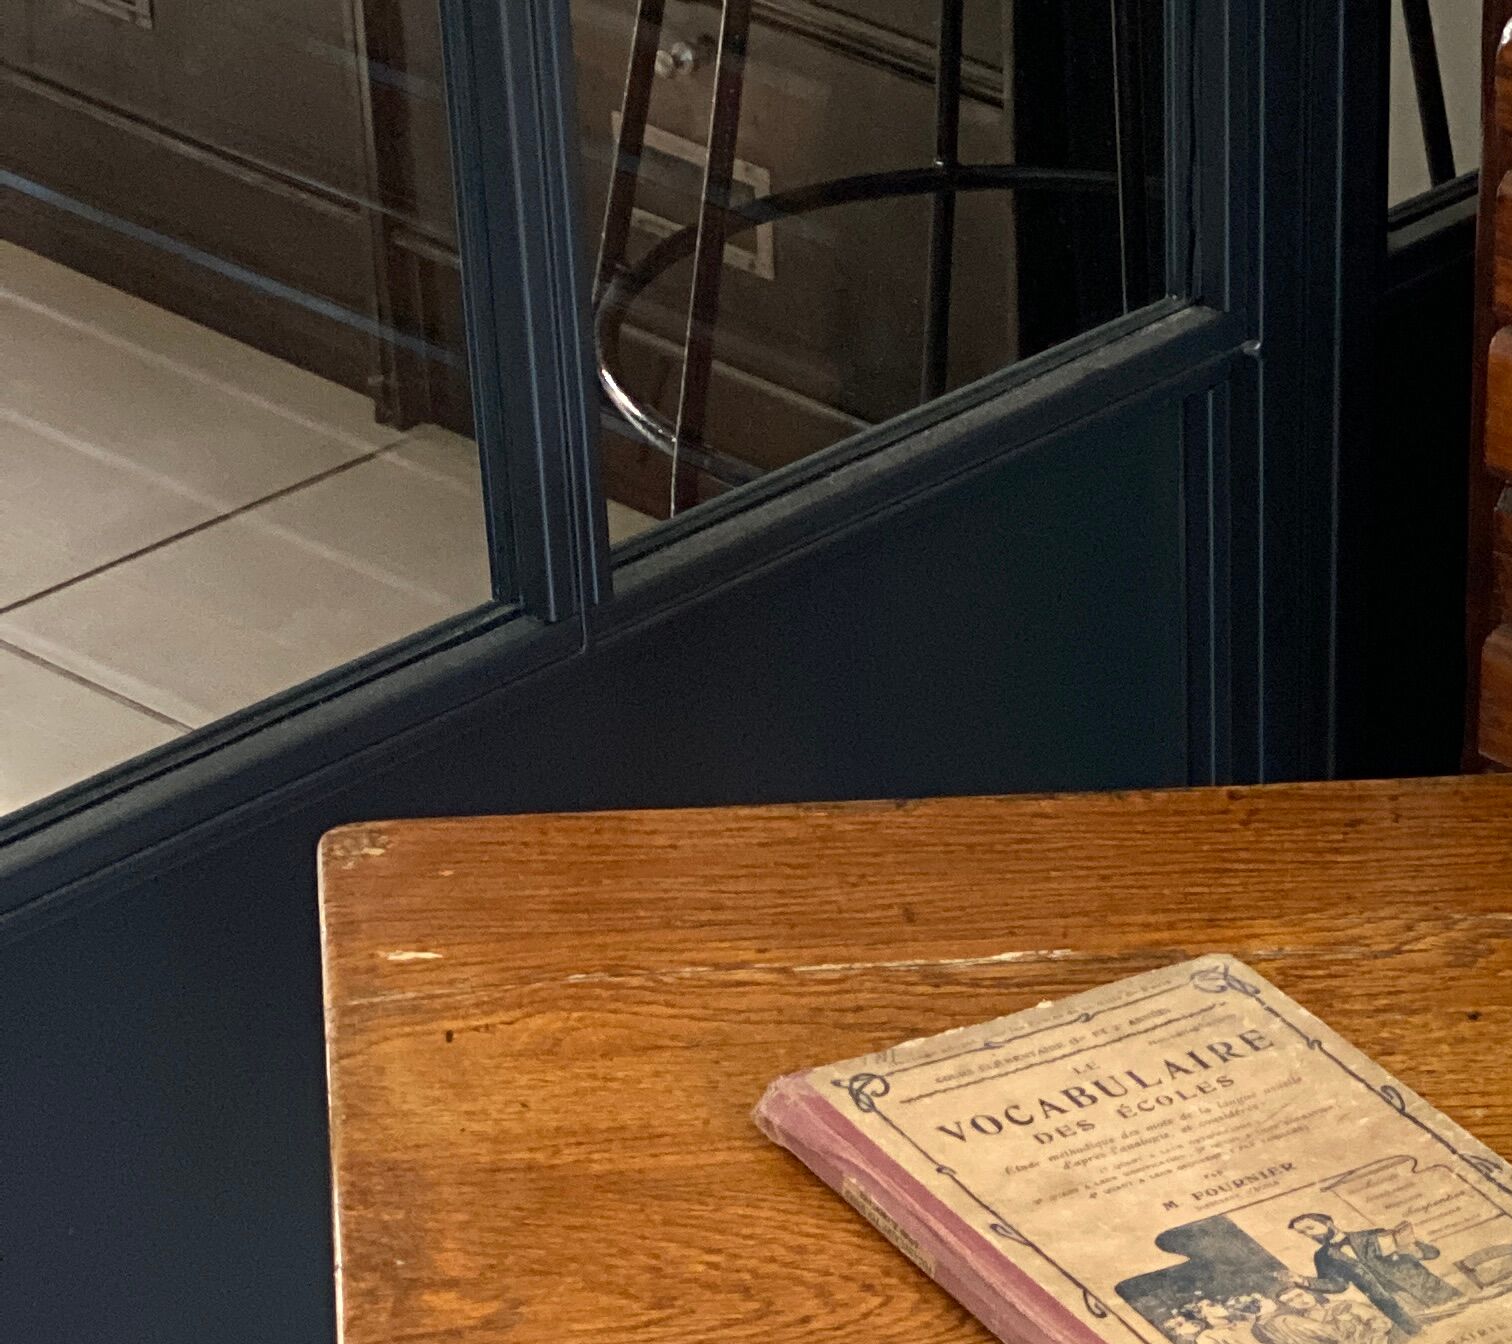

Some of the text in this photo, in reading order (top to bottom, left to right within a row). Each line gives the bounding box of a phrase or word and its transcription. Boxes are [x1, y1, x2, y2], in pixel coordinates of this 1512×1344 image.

[937, 1030, 1276, 1145] VOCABULAIRE
[1069, 1061, 1100, 1074] LE
[1032, 1073, 1237, 1144] DES ÉCOLES
[1190, 1160, 1299, 1201] FOURNIER
